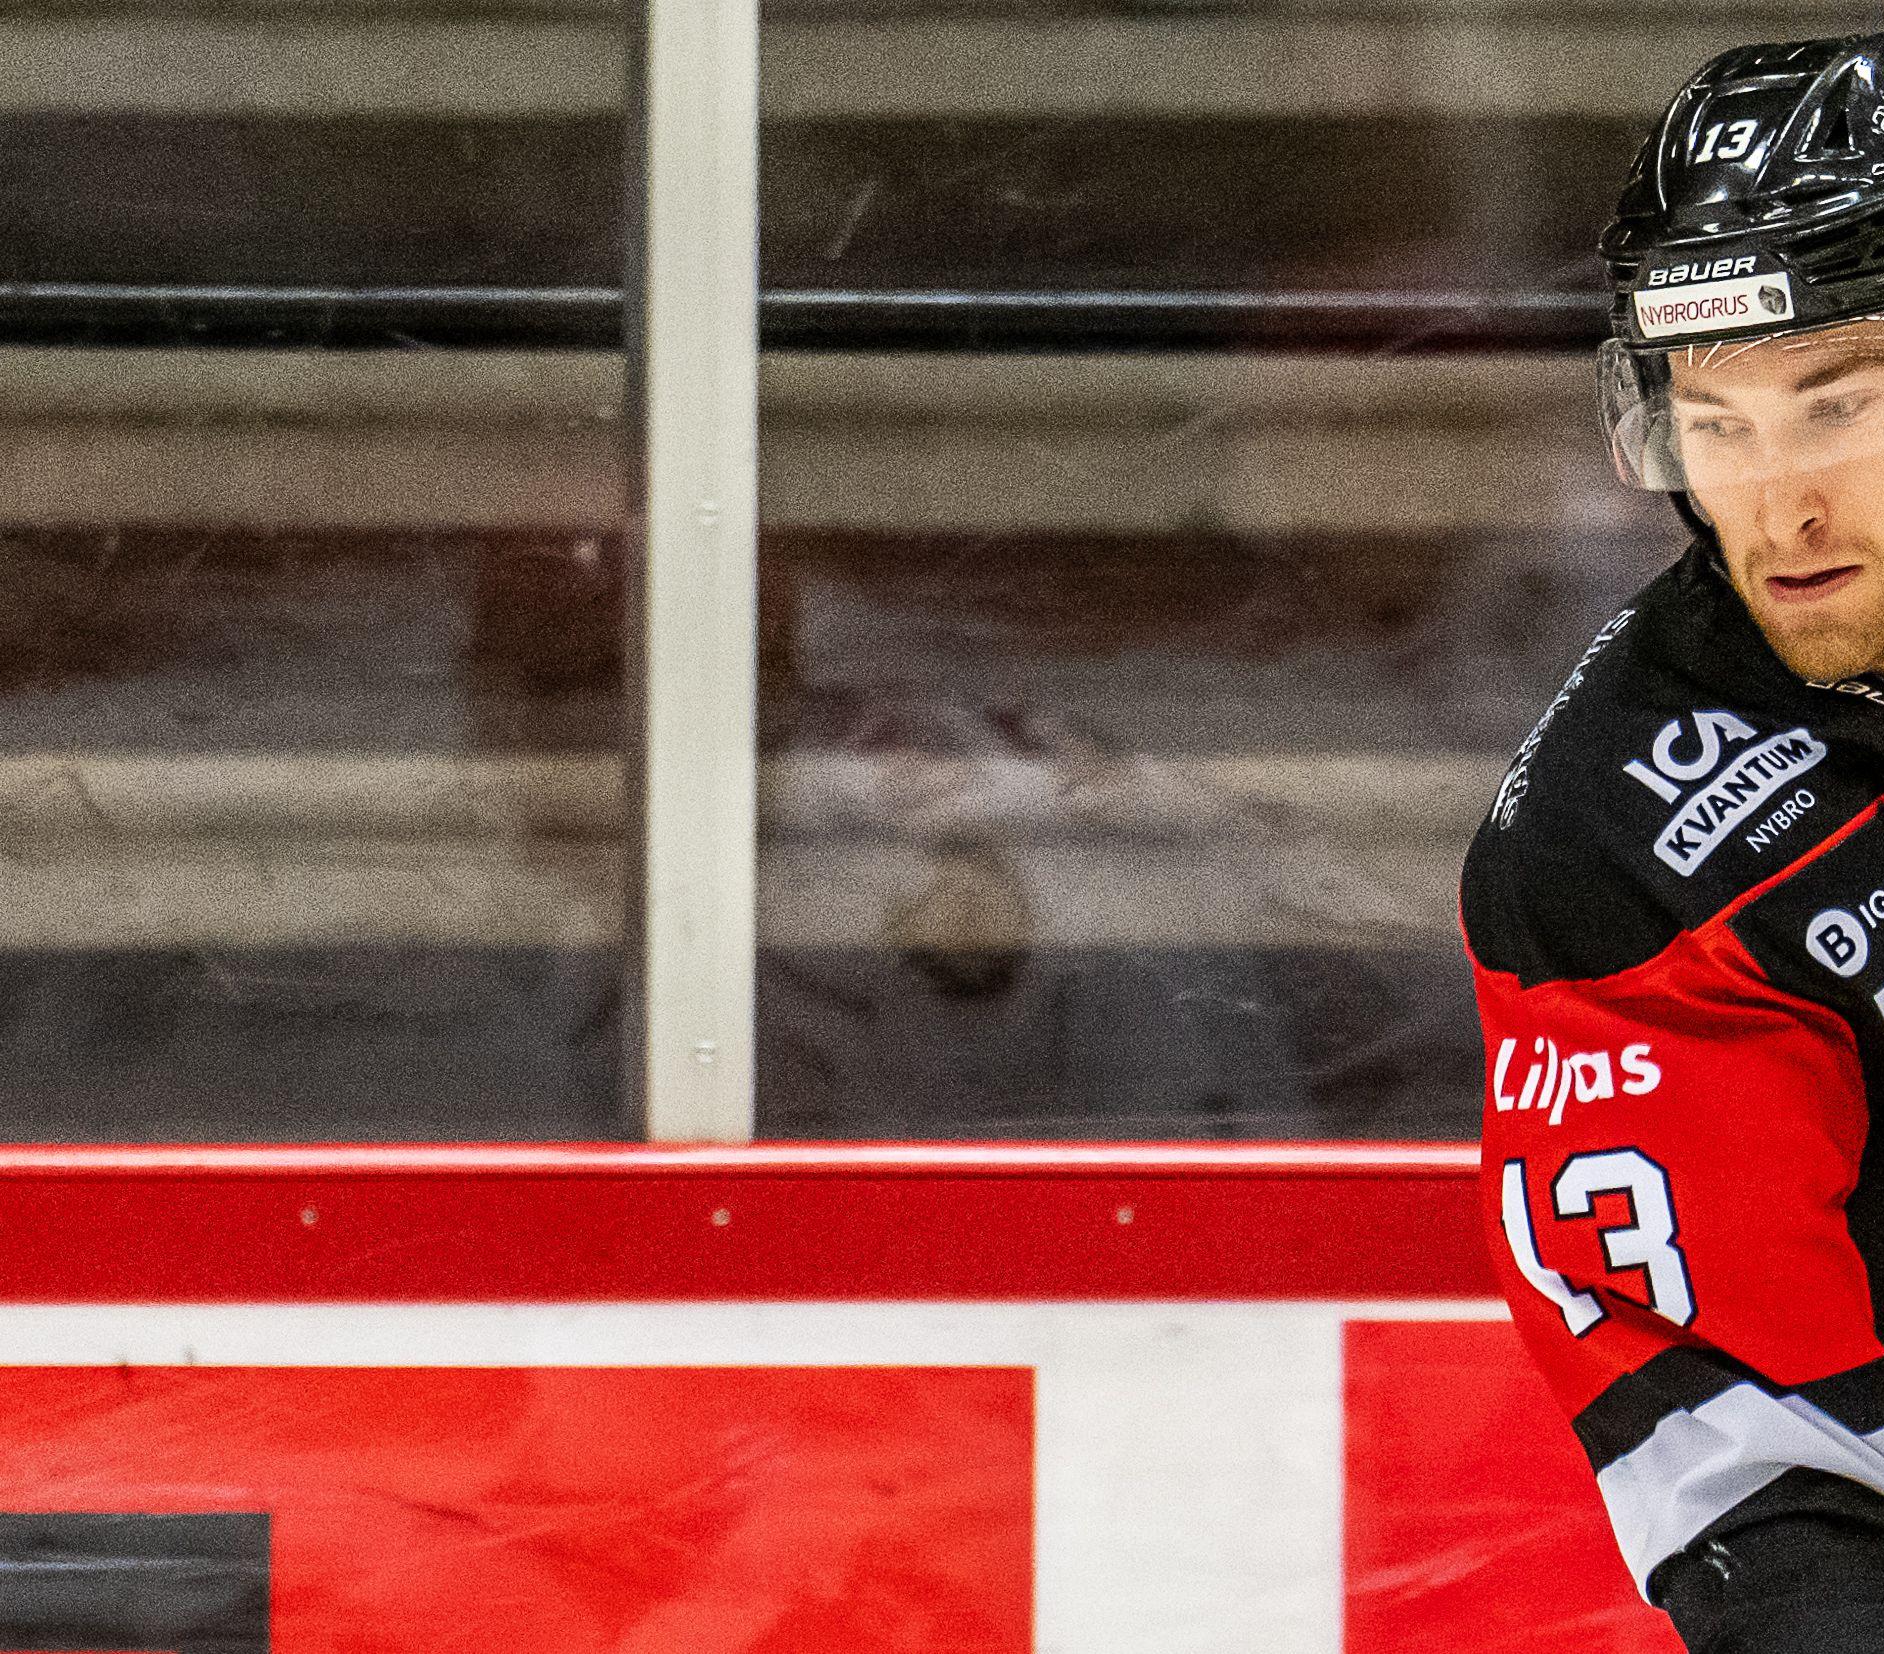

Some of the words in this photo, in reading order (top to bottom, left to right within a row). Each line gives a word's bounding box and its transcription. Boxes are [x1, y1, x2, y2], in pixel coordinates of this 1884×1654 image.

[1694, 120, 1760, 164] 13
[1640, 294, 1751, 328] NYBROGRUS
[1623, 709, 1757, 805] ICA
[1665, 737, 1814, 862] KVANTUM
[1745, 788, 1815, 853] NYBRO
[1500, 1146, 1699, 1340] 13
